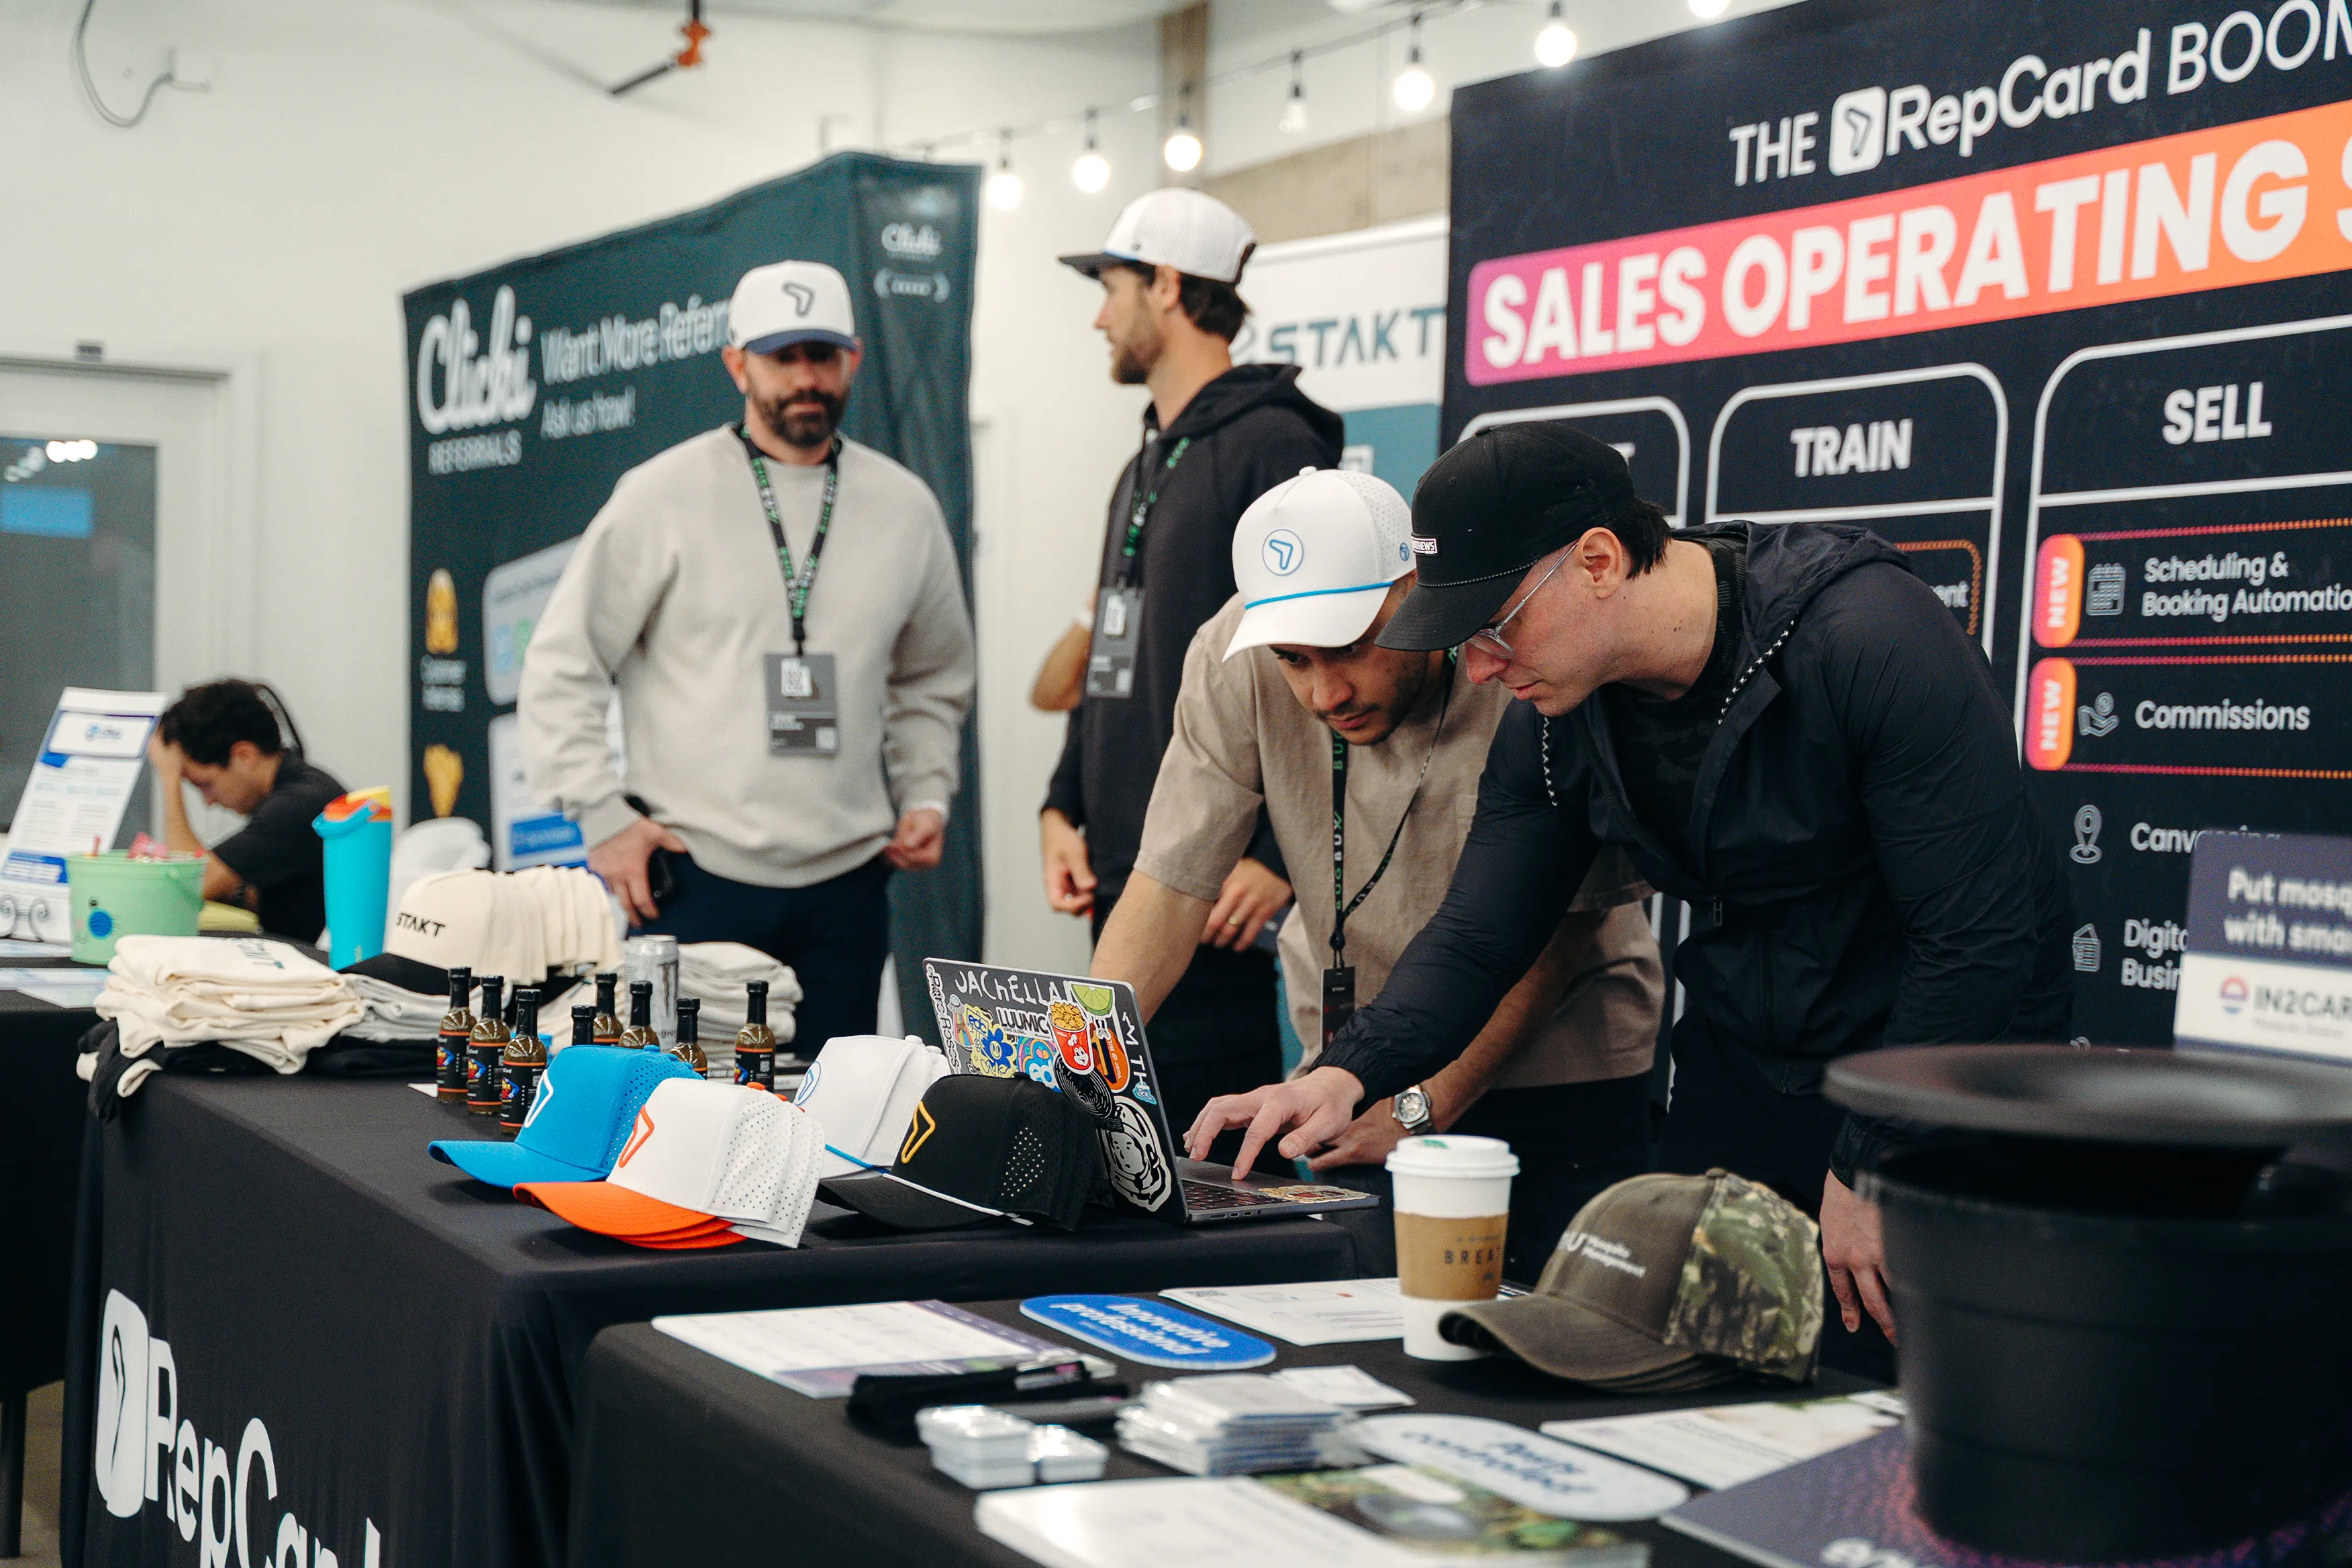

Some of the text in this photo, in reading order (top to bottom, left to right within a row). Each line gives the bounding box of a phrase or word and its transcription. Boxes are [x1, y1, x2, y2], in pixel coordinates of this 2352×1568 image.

[1730, 113, 1818, 186] THE
[1887, 27, 2151, 157] RepCard
[1481, 246, 1707, 370] SALES
[1722, 138, 2310, 338] OPERATING
[540, 324, 601, 385] Want
[601, 313, 658, 373] More
[2162, 381, 2273, 445] SELL
[1790, 418, 1914, 479] TRAIN
[2049, 556, 2069, 628] NEW
[2145, 551, 2289, 586] Scheduling &
[2141, 589, 2229, 623] Booking
[2041, 679, 2062, 752] NEW
[2135, 698, 2310, 731] Commissions
[2224, 910, 2285, 947] with
[144, 1336, 381, 1568] RepC
